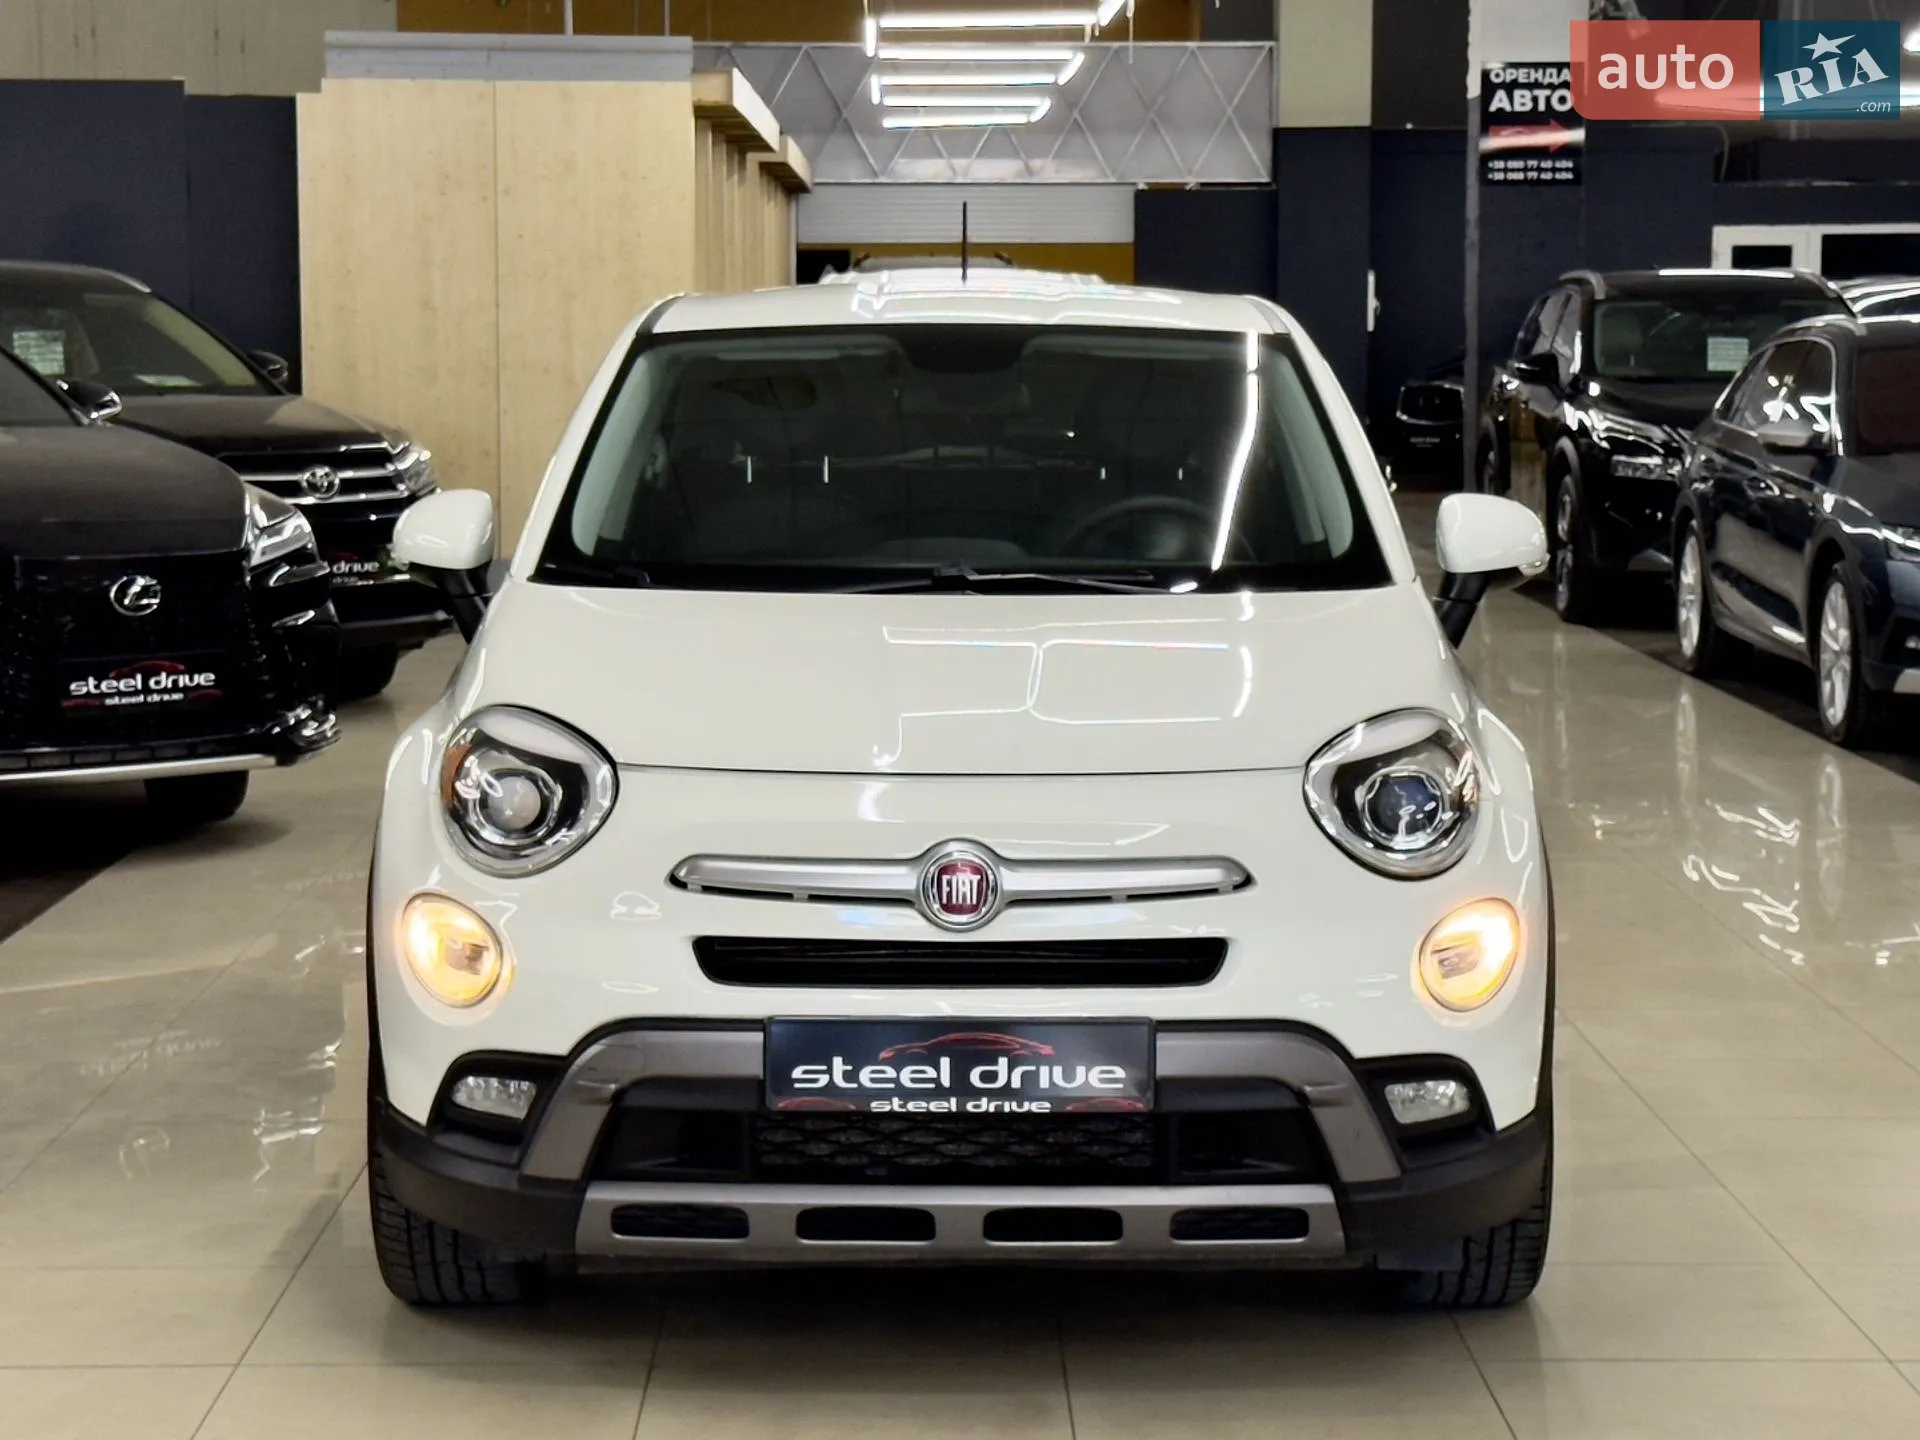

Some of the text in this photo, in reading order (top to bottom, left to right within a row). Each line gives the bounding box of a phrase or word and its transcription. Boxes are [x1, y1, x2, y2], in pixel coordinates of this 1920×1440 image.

[1489, 67, 1573, 86] ОРЕНДА
[1488, 88, 1575, 112] АВТО
[332, 560, 380, 574] drive
[69, 671, 216, 696] steel drive
[104, 692, 184, 706] steel drive
[941, 872, 981, 905] FIAT
[791, 1056, 1127, 1089] steel drive
[869, 1097, 1052, 1113] steel drive
